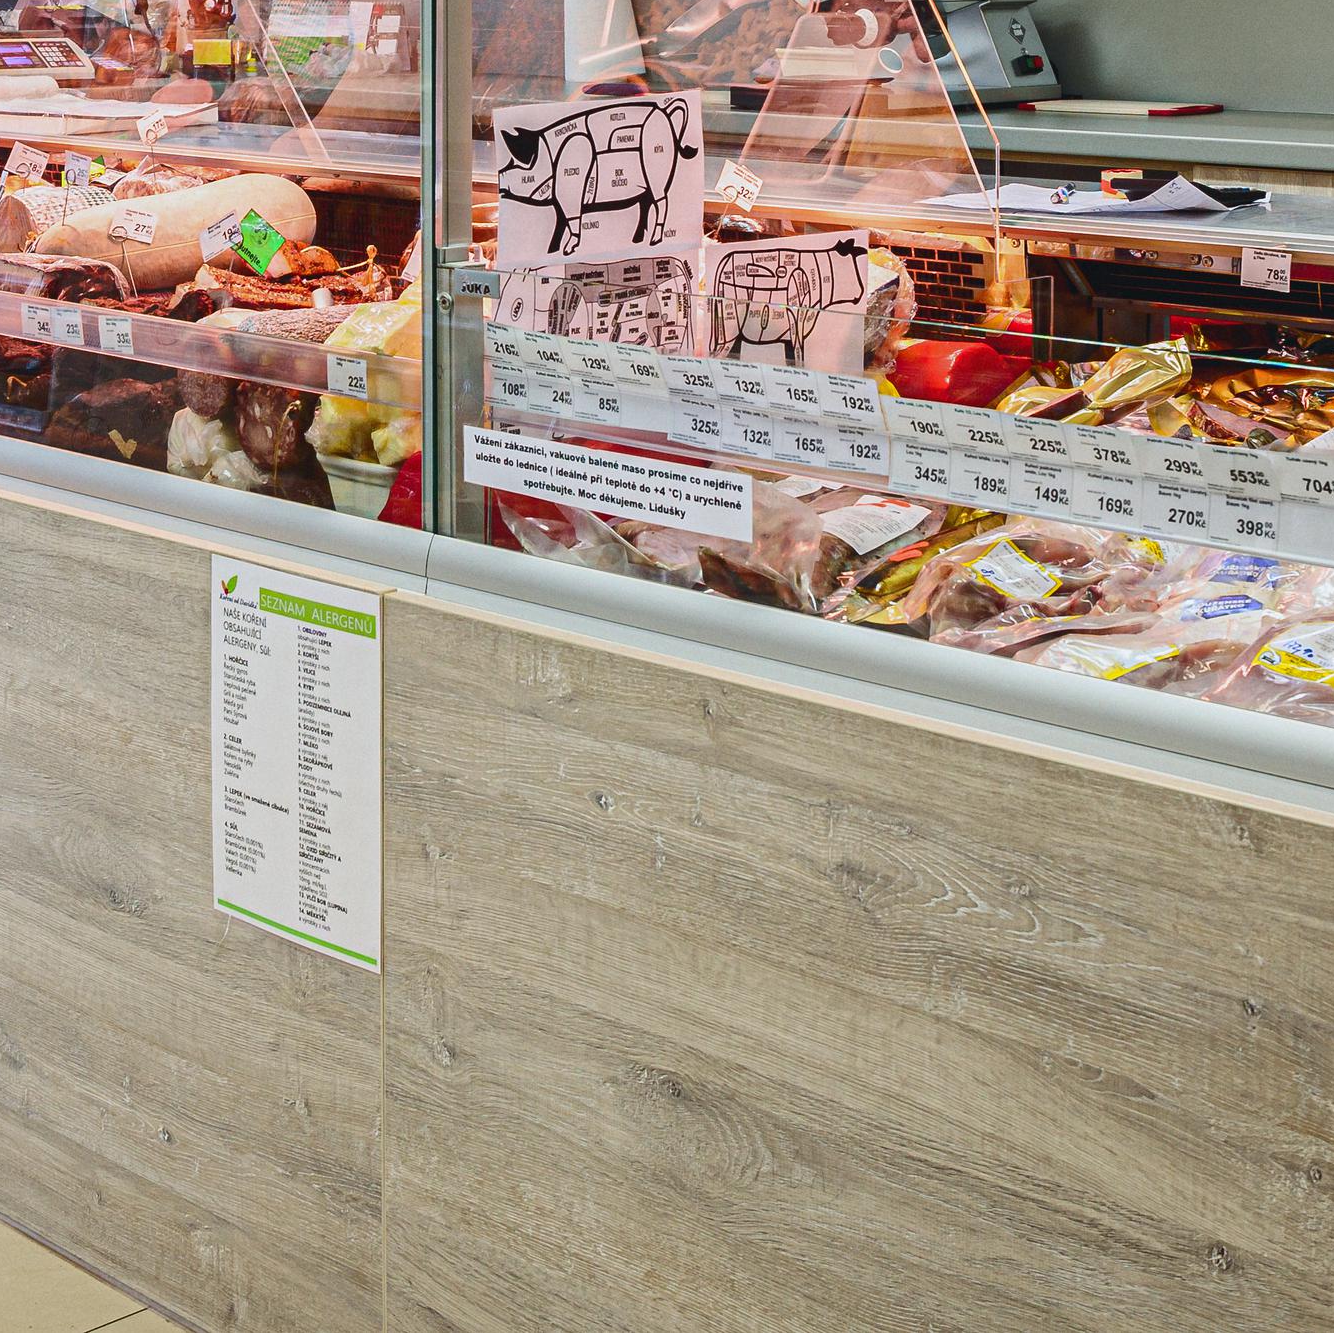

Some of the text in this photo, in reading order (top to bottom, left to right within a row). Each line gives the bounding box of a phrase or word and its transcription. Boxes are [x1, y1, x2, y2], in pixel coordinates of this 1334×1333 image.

[461, 282, 490, 295] JUKA
[1267, 269, 1279, 280] 78
[474, 434, 744, 493] Vážení zákazníci, vakuově balené maso prosíme co nejdříve
[475, 452, 501, 465] uložte
[504, 456, 514, 467] do
[516, 459, 547, 474] lednice
[605, 476, 637, 492] teplotě
[639, 483, 651, 494] do
[654, 485, 666, 497] +4
[685, 493, 691, 501] a
[694, 494, 742, 511] urychleně
[523, 478, 686, 519] spotřebujte. Moc děkujeme. Lidušky
[223, 608, 267, 628] NAŠE KOŘENÍ
[260, 594, 373, 634] SEZNAM ALERGENŮ
